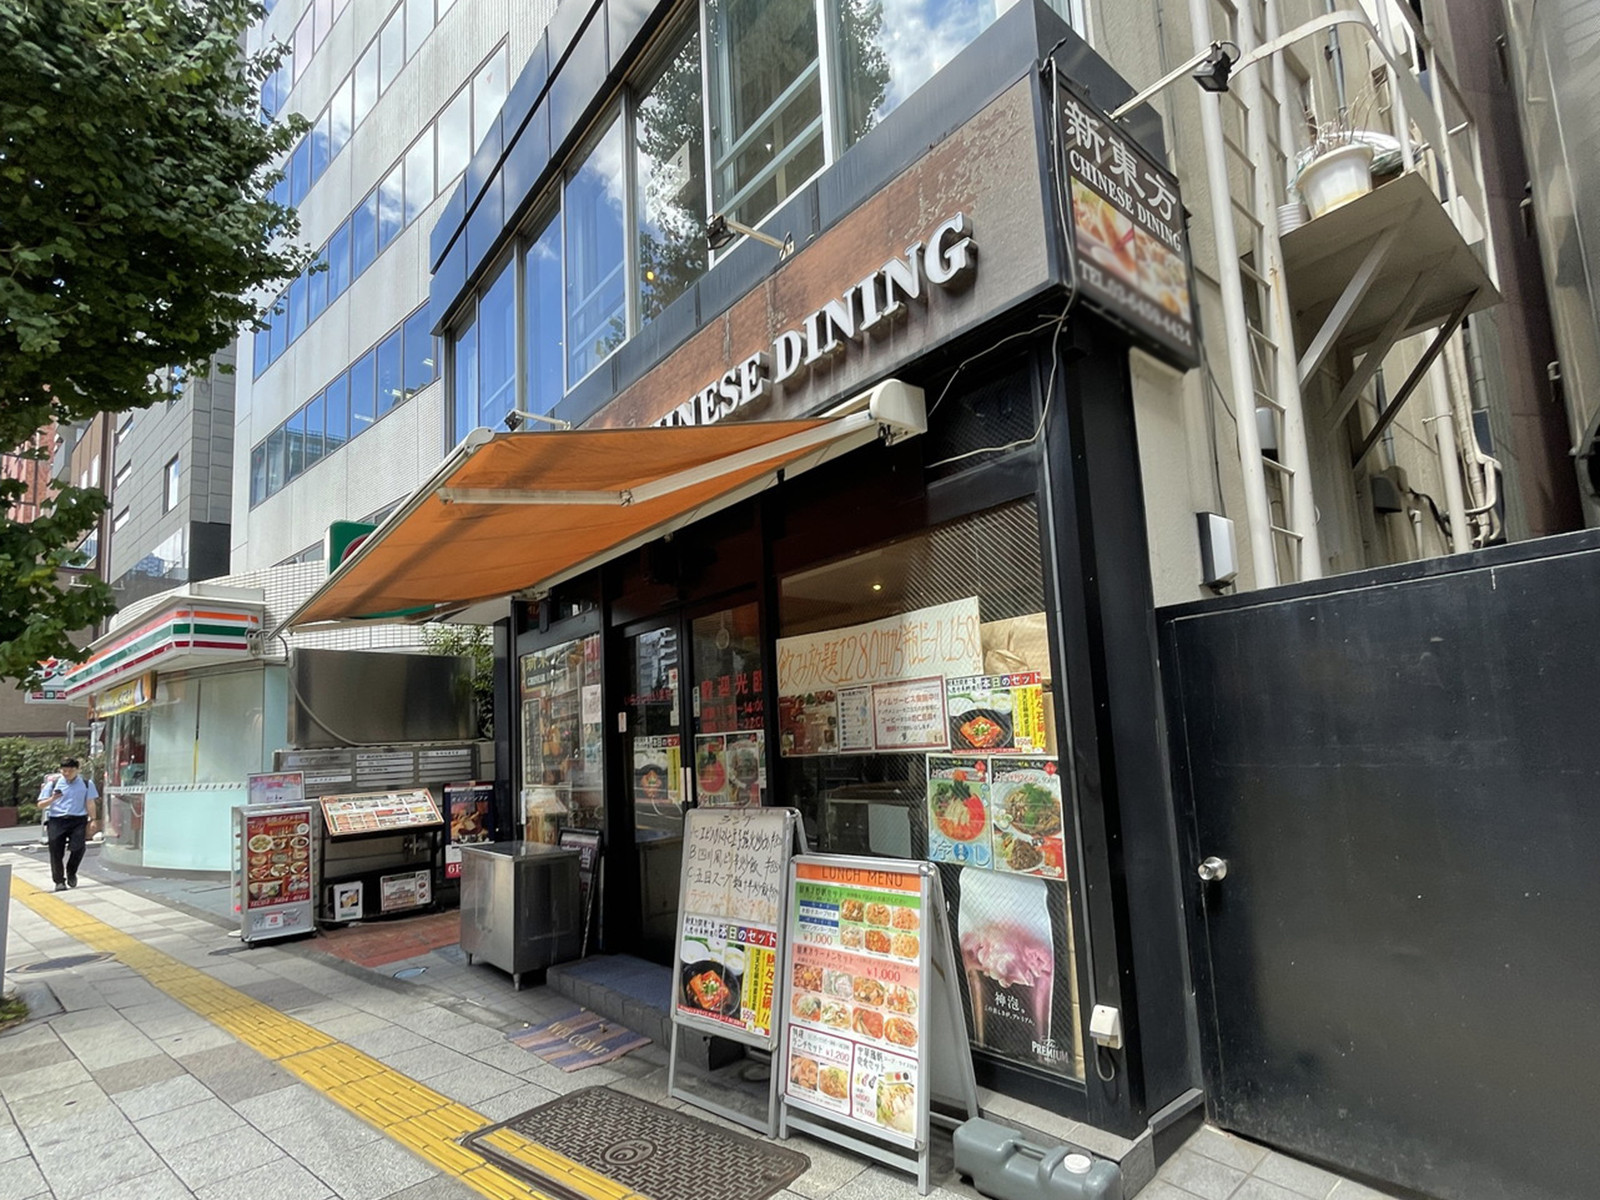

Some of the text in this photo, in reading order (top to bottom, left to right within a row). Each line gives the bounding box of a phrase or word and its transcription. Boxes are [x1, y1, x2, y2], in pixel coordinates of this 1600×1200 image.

[1064, 100, 1177, 221] 新東方
[1069, 149, 1182, 252] CHINESE DINING
[774, 212, 977, 384] DINING
[981, 672, 1041, 690] 本日のセット
[821, 867, 904, 888] LUNCH MENU
[718, 924, 777, 946] 本日のセット
[866, 967, 901, 982] ¥1,000
[547, 1021, 610, 1056] WELCOME
[1031, 1040, 1070, 1065] PREMIUM
